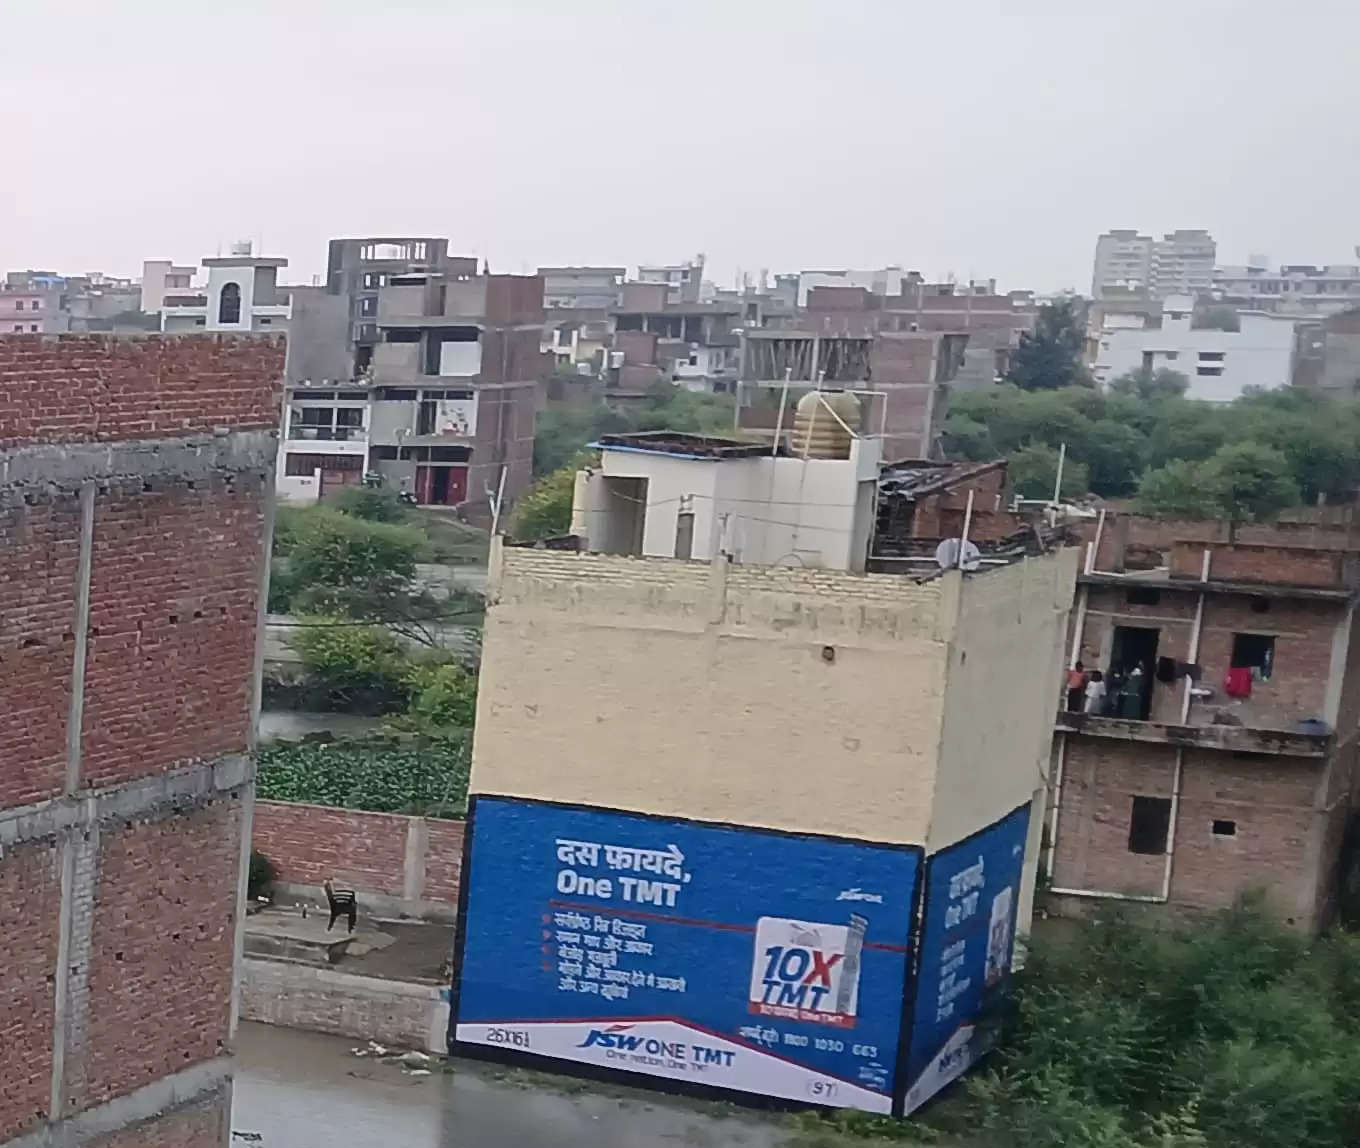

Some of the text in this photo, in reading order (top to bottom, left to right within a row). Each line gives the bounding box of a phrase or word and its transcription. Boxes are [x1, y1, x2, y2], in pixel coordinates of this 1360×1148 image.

[555, 839, 601, 867] दस
[556, 869, 680, 907] One TMT
[764, 946, 845, 987] 10X
[761, 979, 829, 1014] TMT
[577, 1030, 736, 1067] JSW ONE TMT
